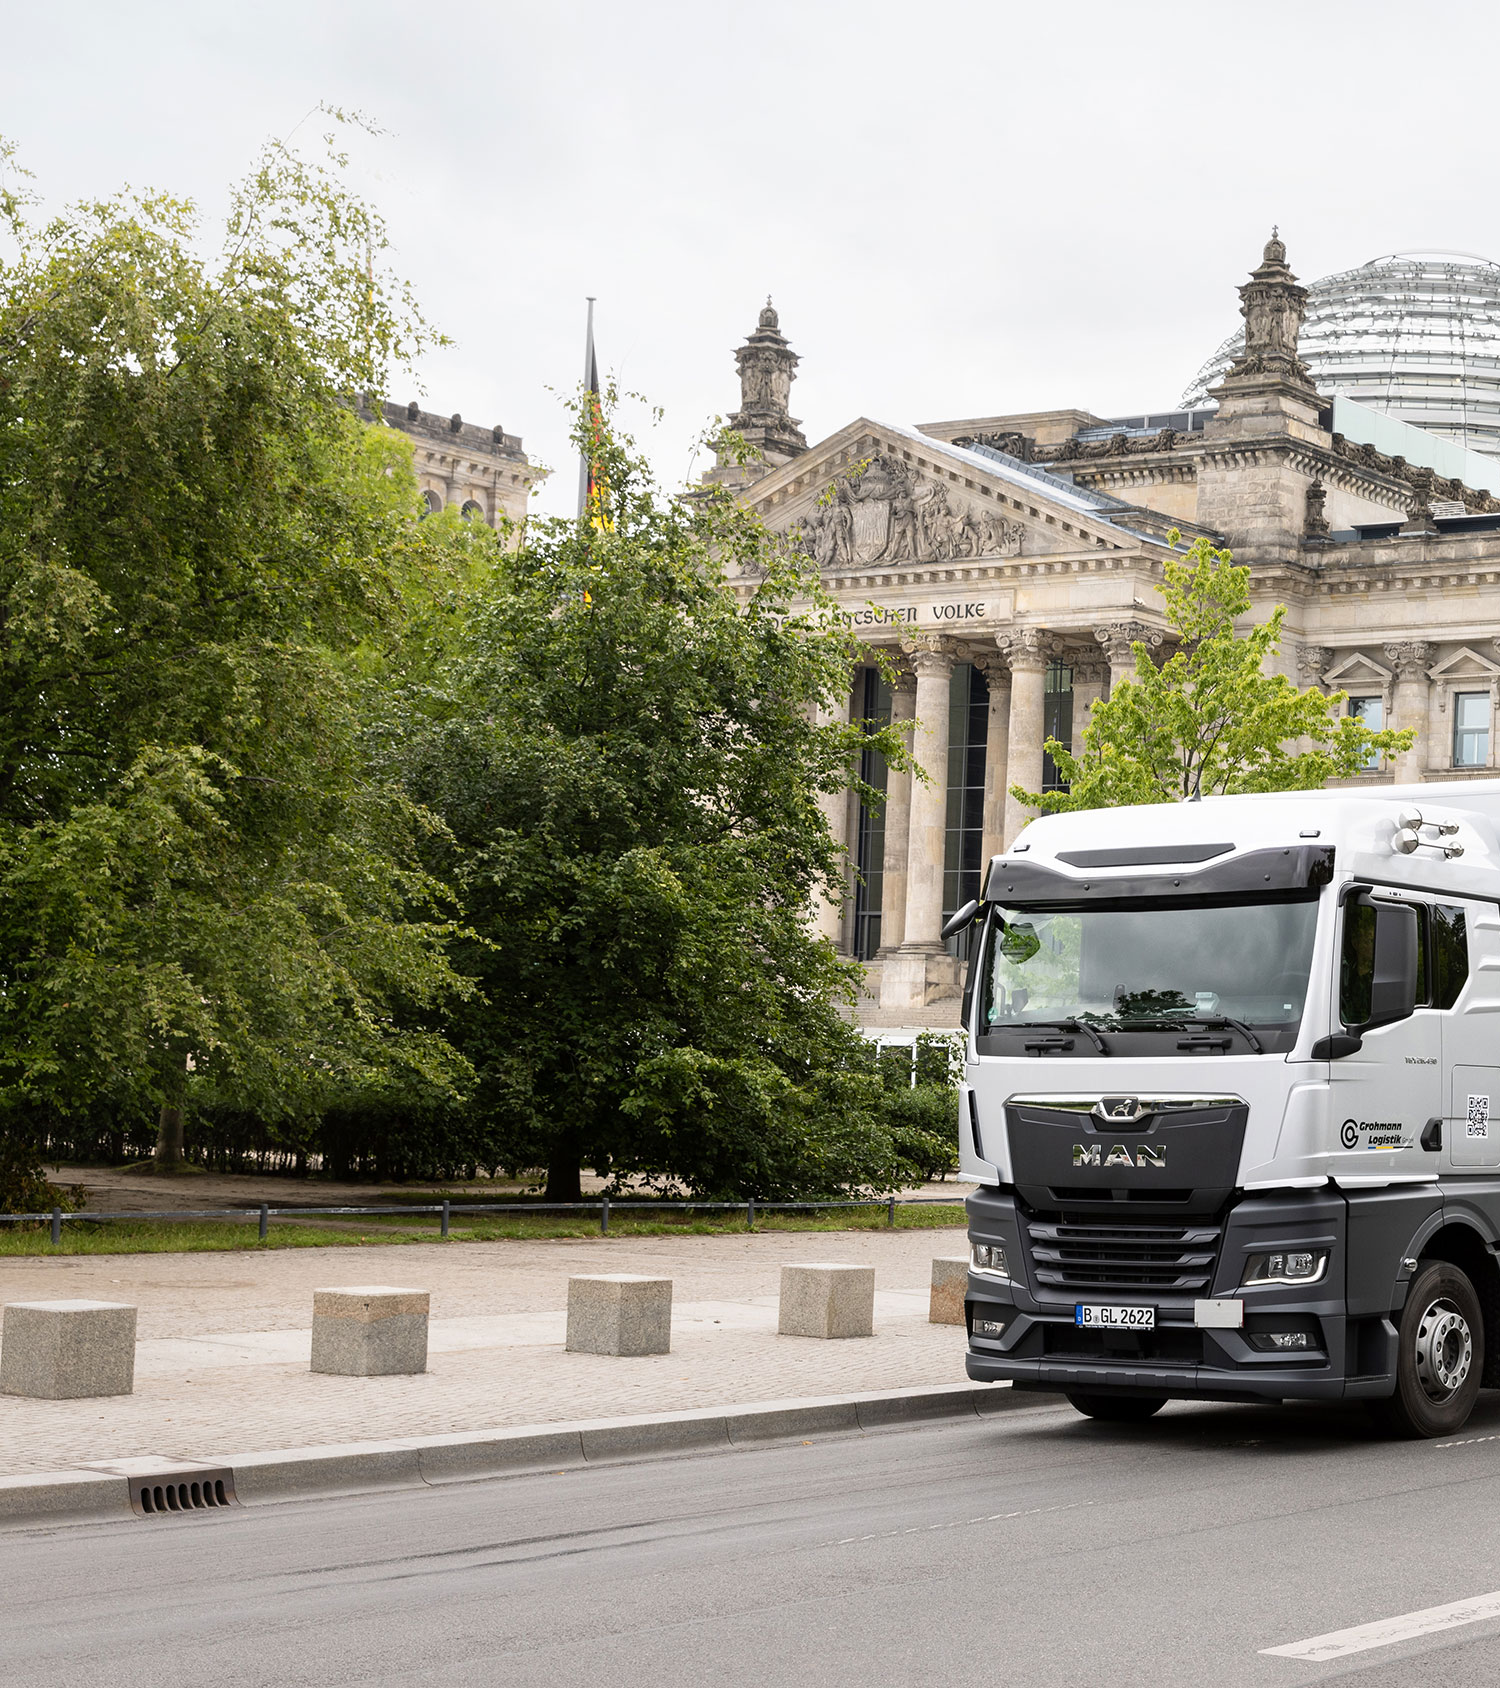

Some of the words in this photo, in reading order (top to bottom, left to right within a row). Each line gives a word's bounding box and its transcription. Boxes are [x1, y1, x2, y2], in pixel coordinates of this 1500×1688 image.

[932, 603, 985, 620] VOLKE
[1359, 1121, 1402, 1131] Grohmann
[1368, 1134, 1402, 1145] Logistik
[1072, 1144, 1167, 1168] MAN
[1084, 1307, 1092, 1323] B
[1101, 1308, 1117, 1324] GL
[1120, 1309, 1153, 1326] 2622
